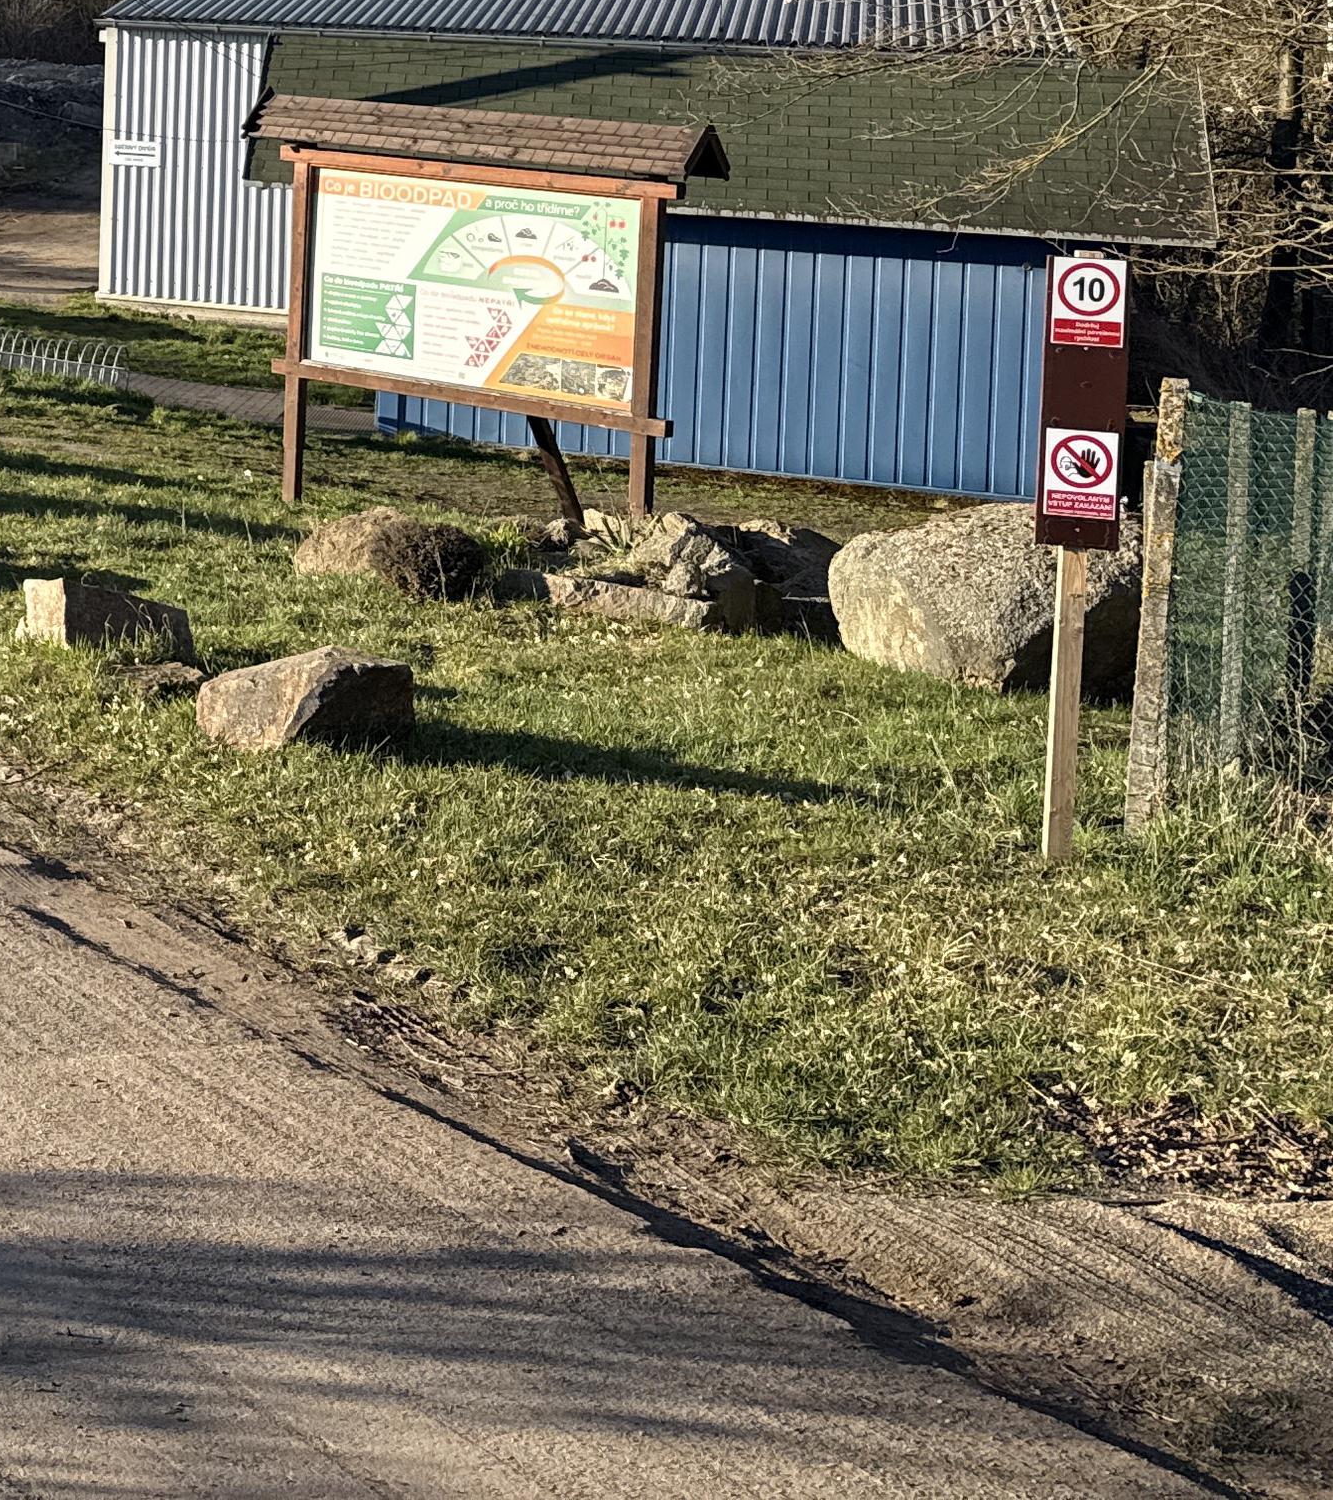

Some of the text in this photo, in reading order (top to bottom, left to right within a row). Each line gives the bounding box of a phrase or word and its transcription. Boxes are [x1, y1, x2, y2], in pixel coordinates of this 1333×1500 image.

[324, 179, 472, 209] Co je BIOODPAD
[485, 199, 580, 216] a proč ho třídíme?
[1072, 276, 1105, 303] 10
